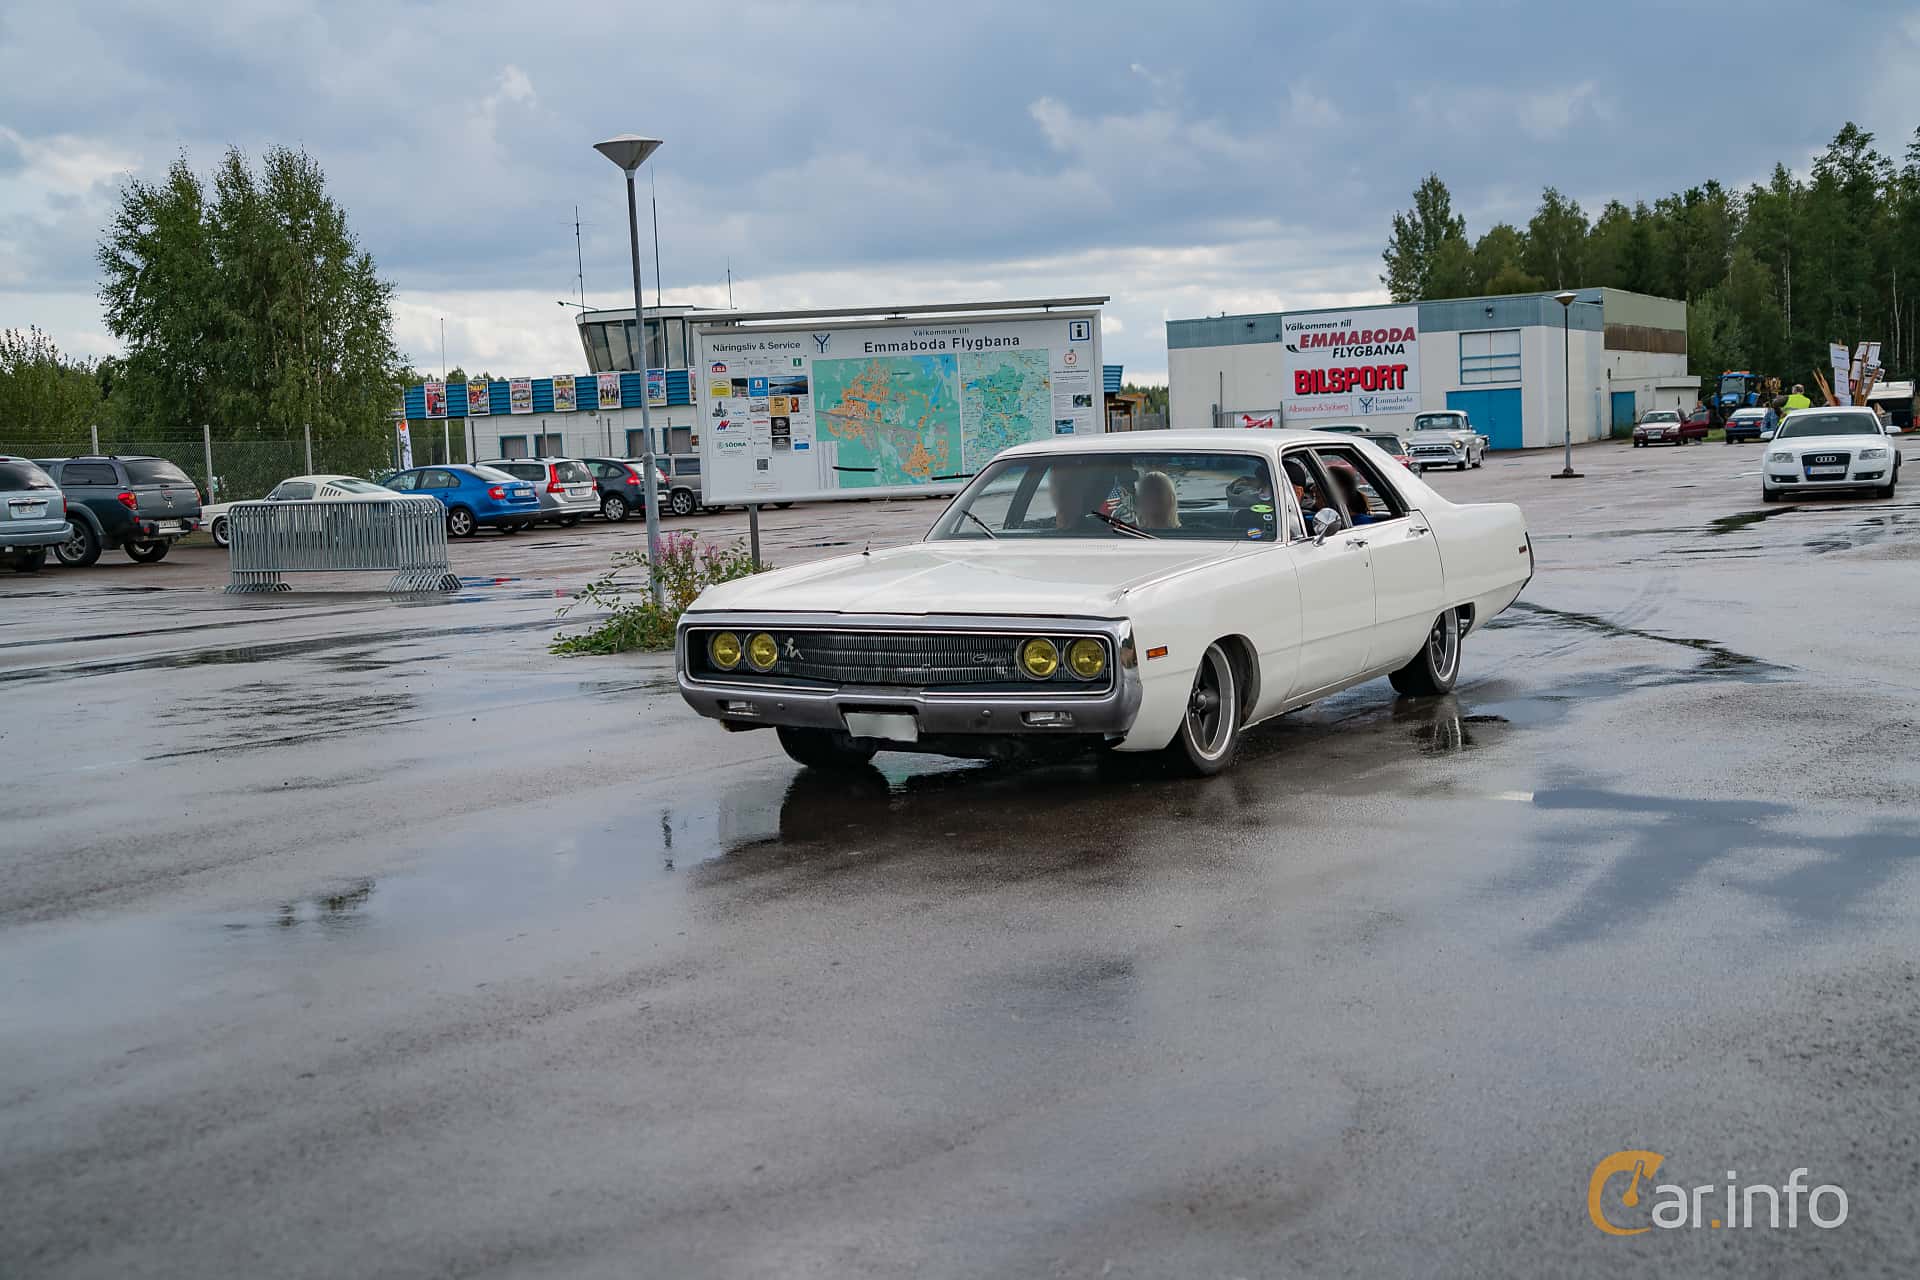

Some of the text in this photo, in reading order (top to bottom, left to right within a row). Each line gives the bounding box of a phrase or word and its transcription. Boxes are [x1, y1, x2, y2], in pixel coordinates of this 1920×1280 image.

[913, 328, 956, 337] Välkommen
[1285, 319, 1352, 332] Välkommen till
[864, 335, 1020, 353] Emmaboda Flygbana
[1299, 326, 1417, 349] EMMABODA
[712, 341, 801, 353] Näringsliv & Service
[1332, 343, 1406, 359] FLYGBANA
[1294, 363, 1408, 396] BILSPORT
